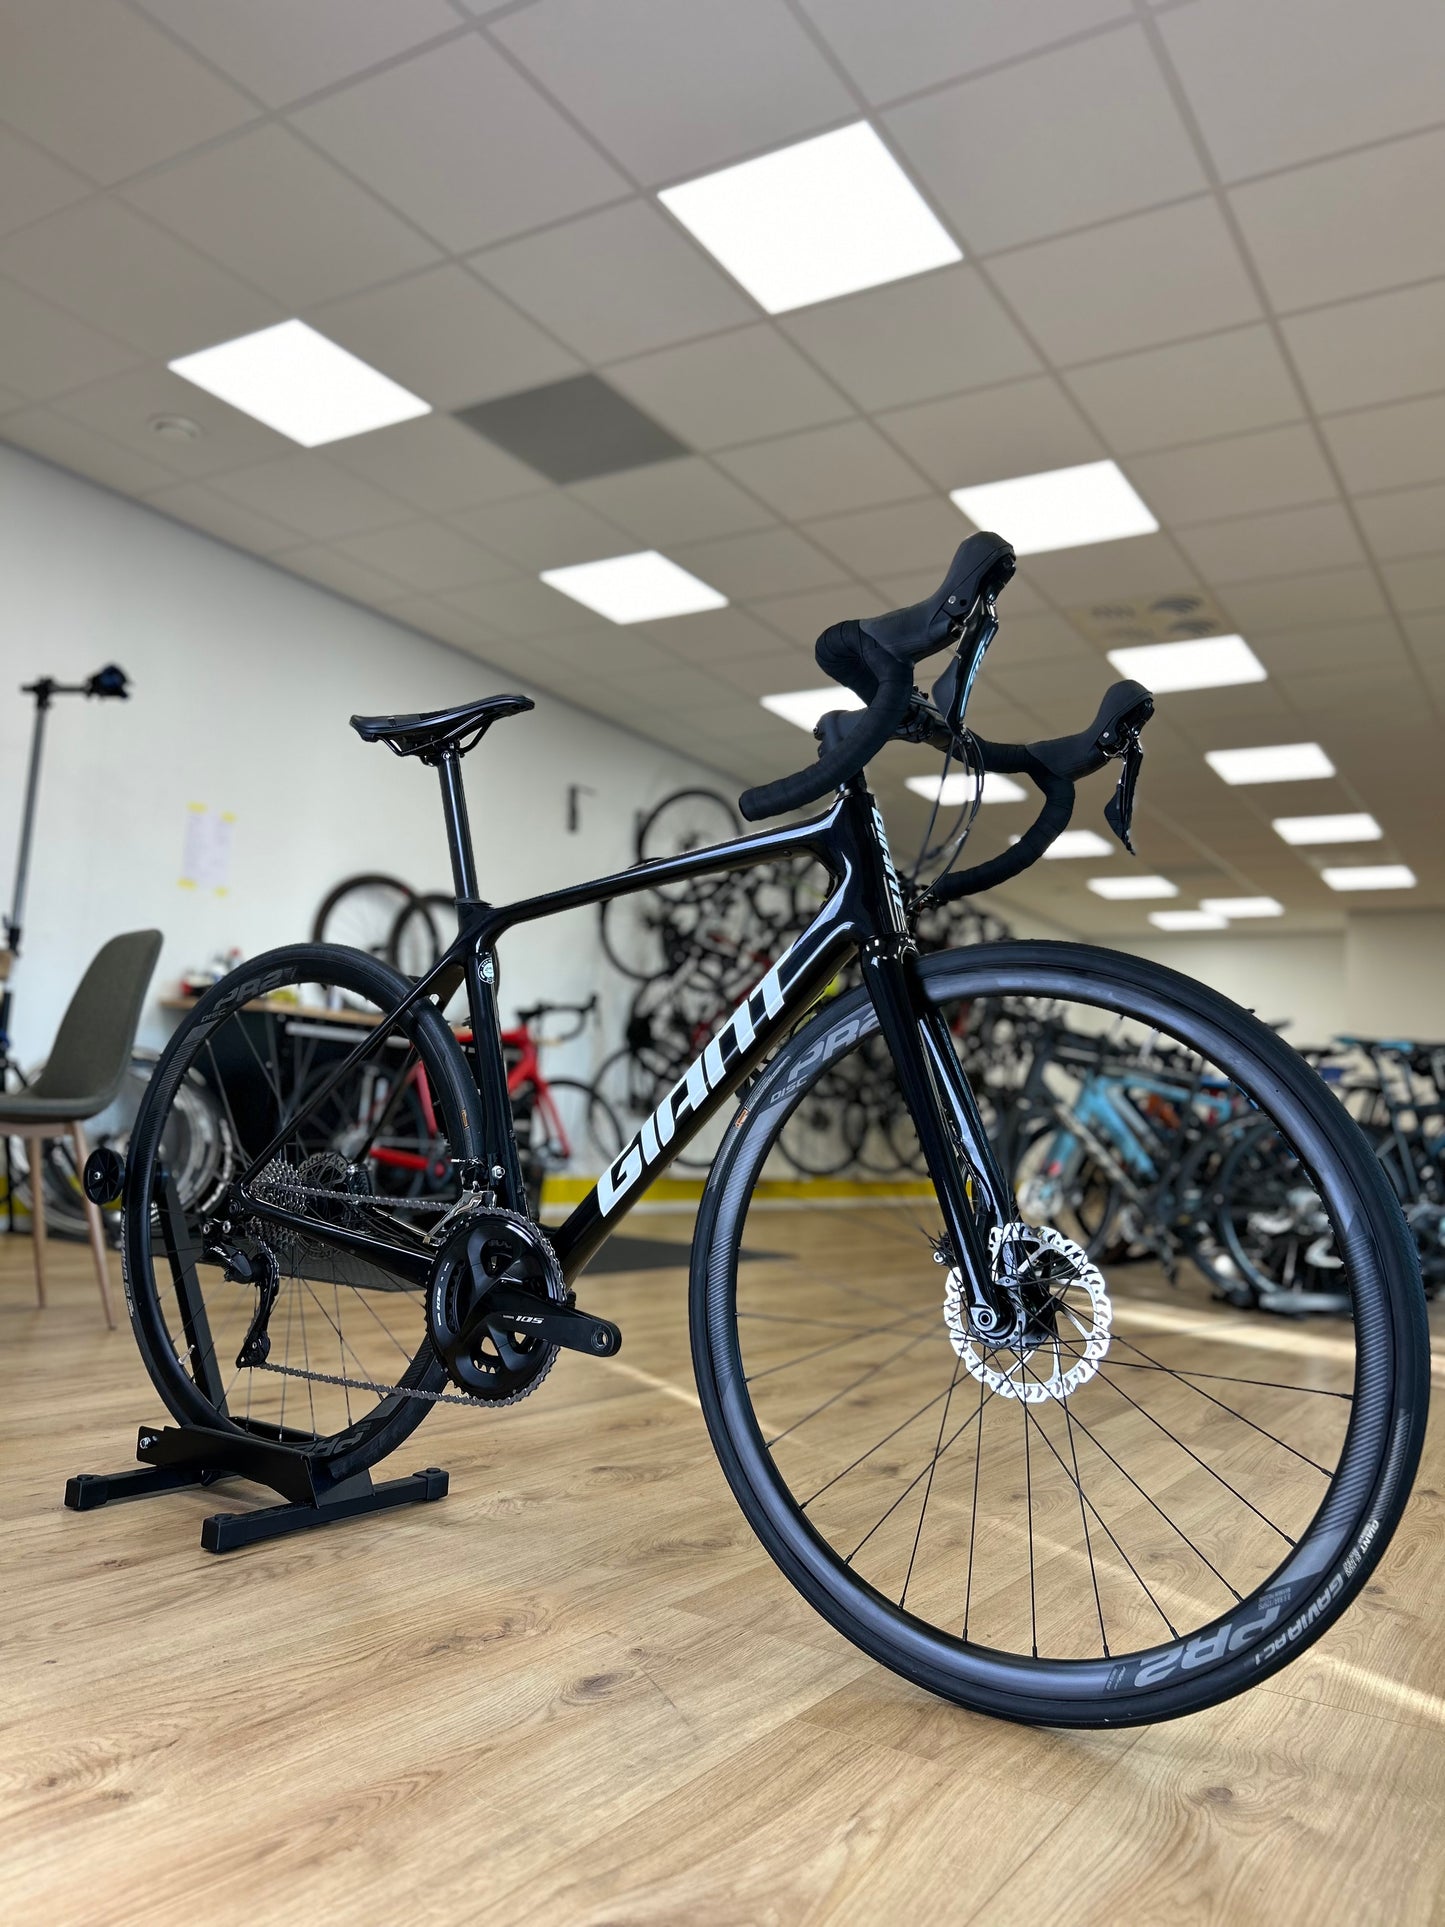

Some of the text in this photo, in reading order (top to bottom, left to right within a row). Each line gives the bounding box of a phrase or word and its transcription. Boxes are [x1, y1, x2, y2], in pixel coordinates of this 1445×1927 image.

[597, 944, 792, 1217] GIANT
[769, 1073, 809, 1104] DISC
[515, 1315, 544, 1324] 105
[1360, 1519, 1380, 1554] GIANT
[1287, 1573, 1344, 1641] GAVIA
[1134, 1605, 1280, 1687] PR2
